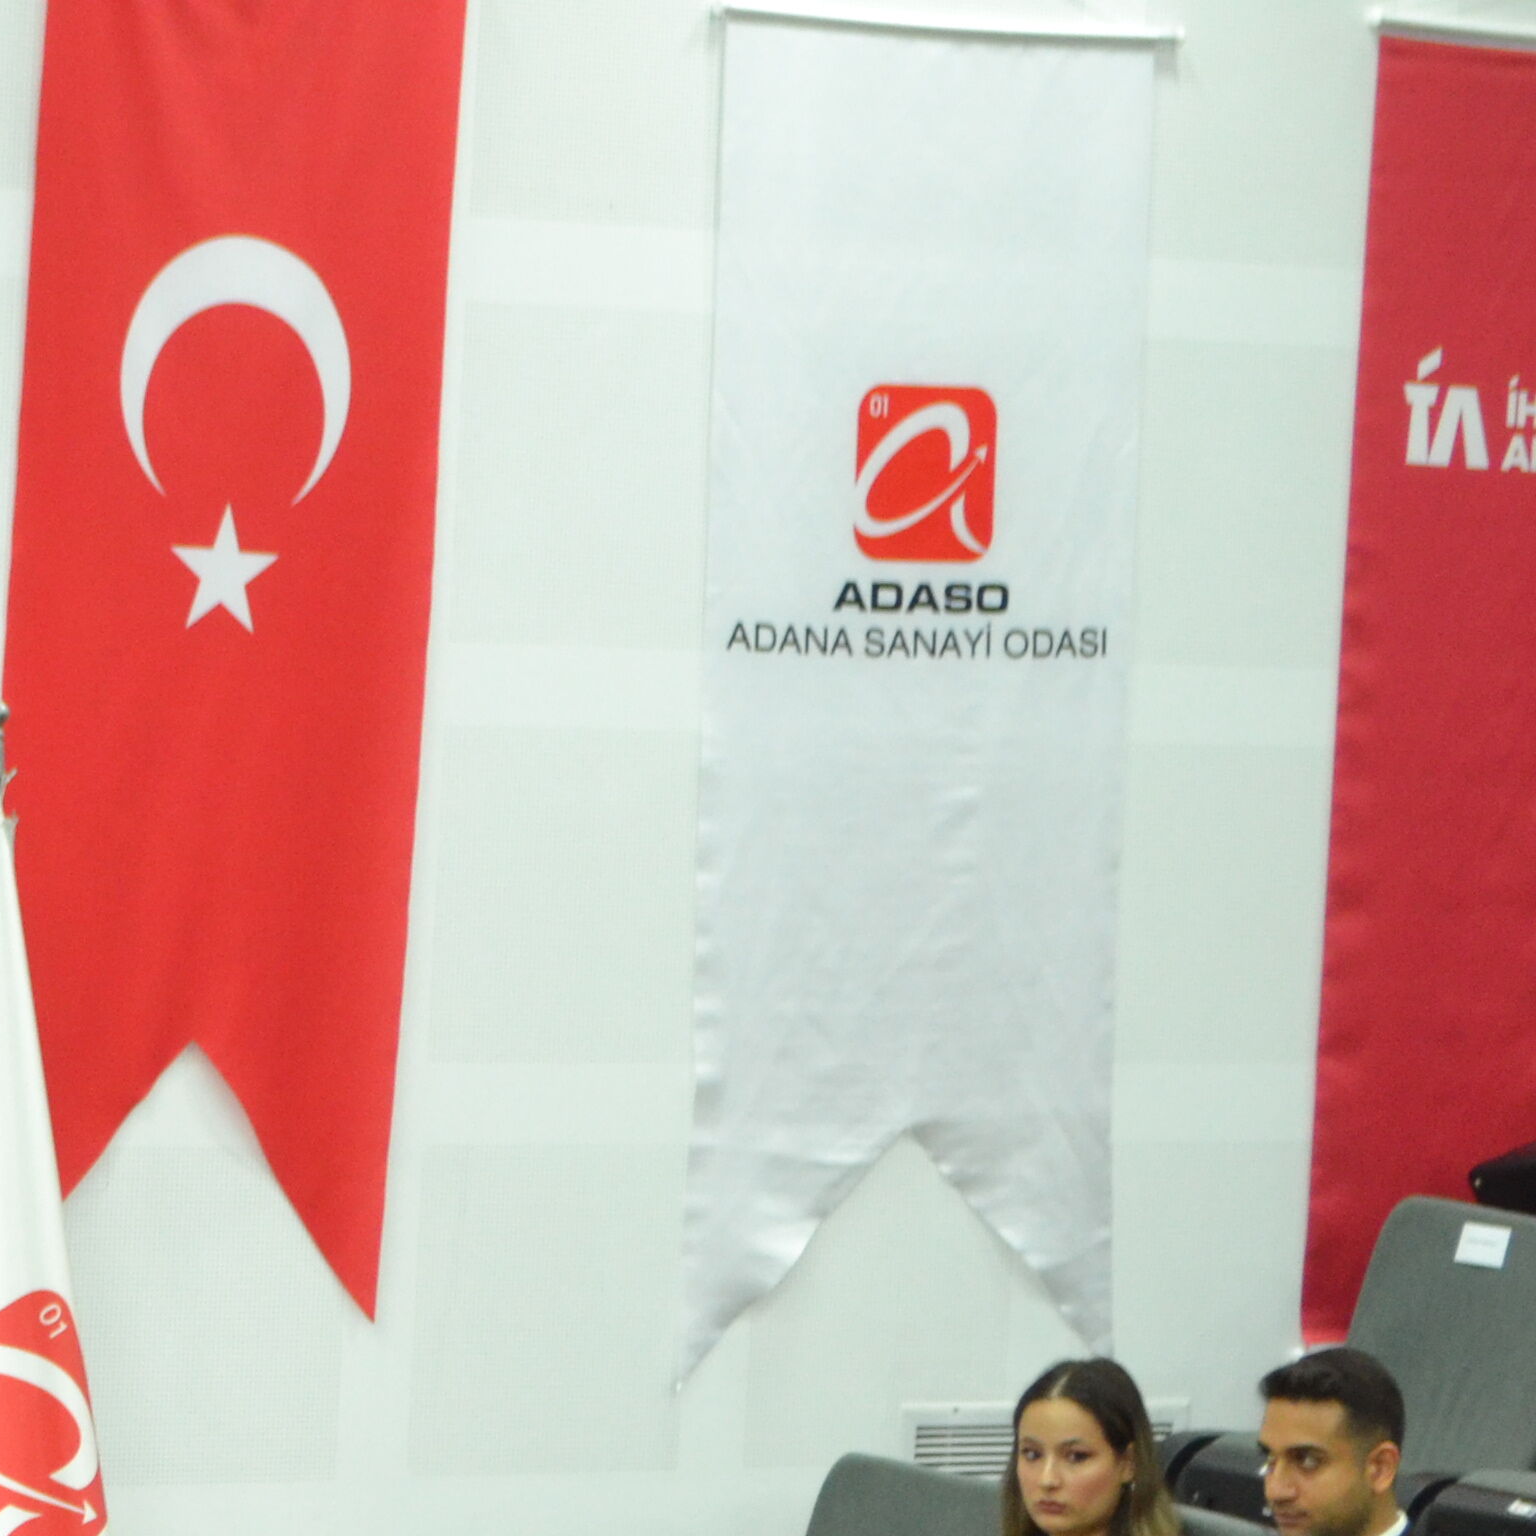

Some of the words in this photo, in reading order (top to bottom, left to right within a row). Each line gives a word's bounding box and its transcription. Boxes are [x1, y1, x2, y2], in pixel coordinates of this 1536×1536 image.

[832, 580, 1011, 614] ADASO
[726, 620, 853, 658] ADANA
[863, 621, 992, 659] SANAYİ
[1002, 626, 1109, 661] ODASI
[38, 1302, 68, 1340] 01
